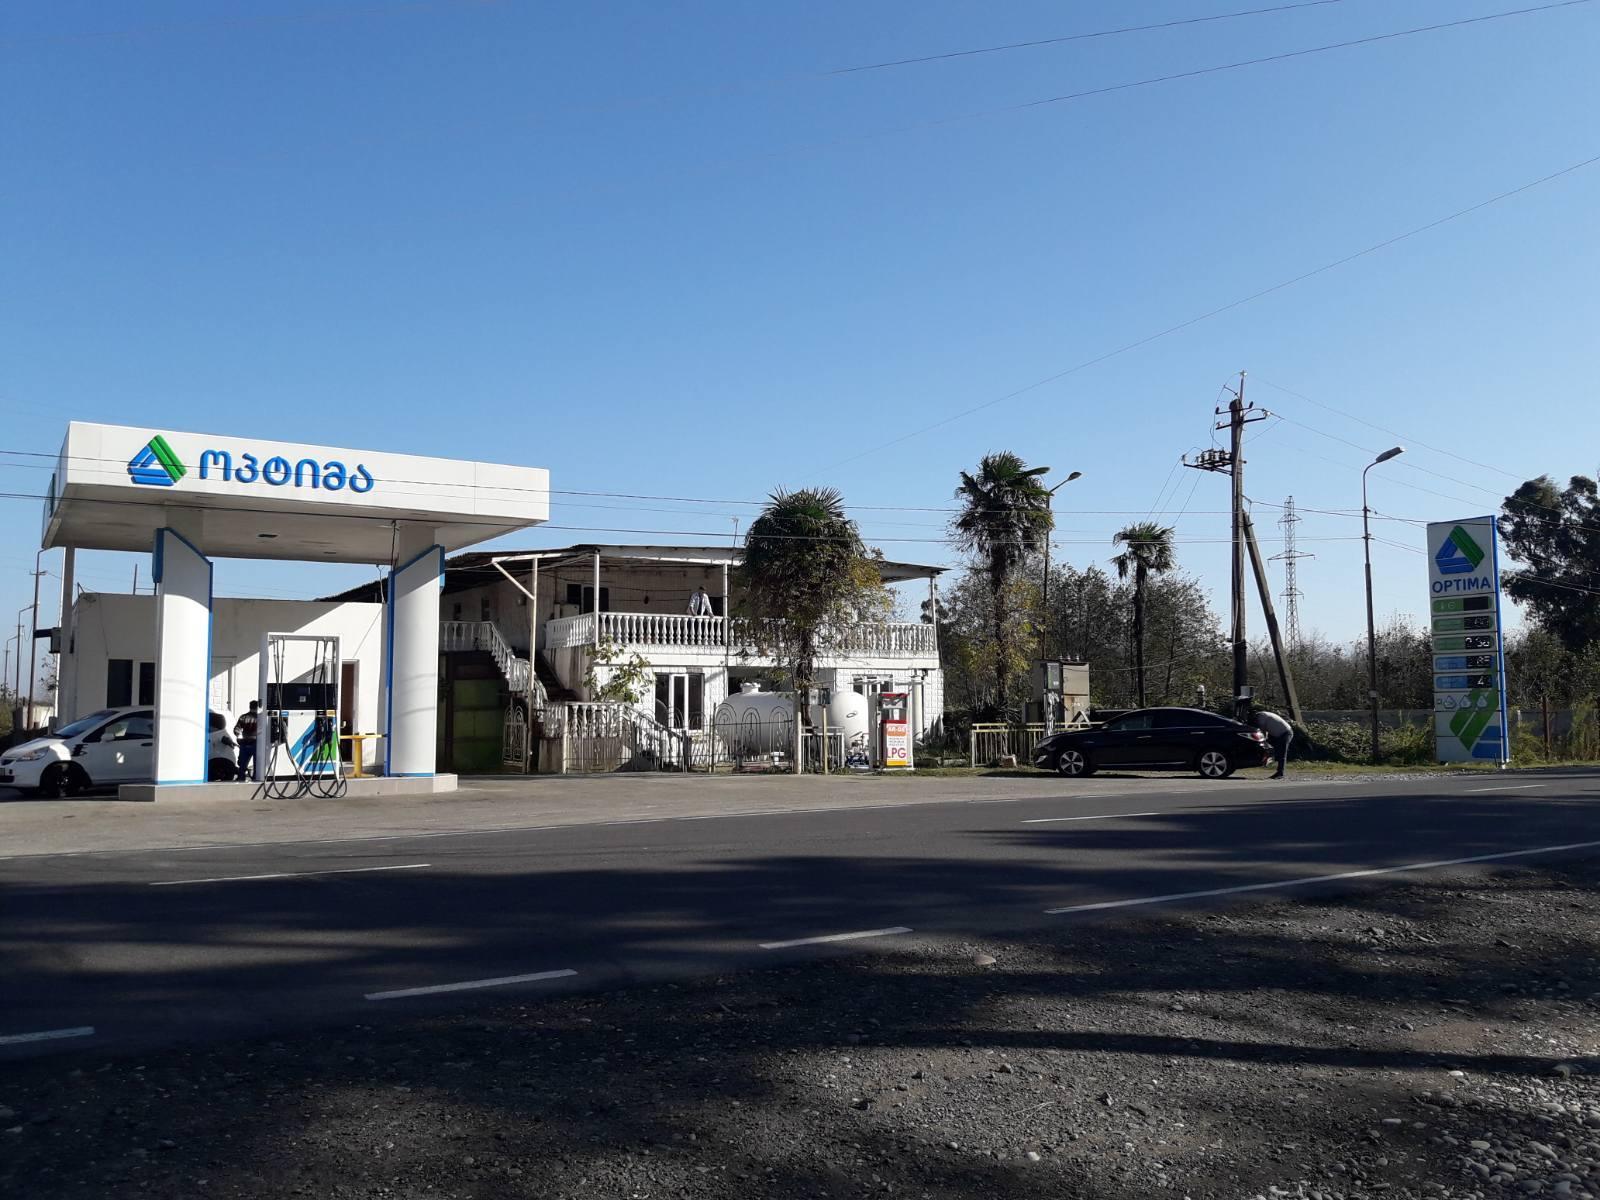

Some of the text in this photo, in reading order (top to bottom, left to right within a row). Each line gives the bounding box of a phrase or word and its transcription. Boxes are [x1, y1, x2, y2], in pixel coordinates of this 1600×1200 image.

[199, 448, 375, 493] ოპტიმა
[1432, 577, 1491, 593] OPTIMA
[887, 747, 906, 759] LPG
